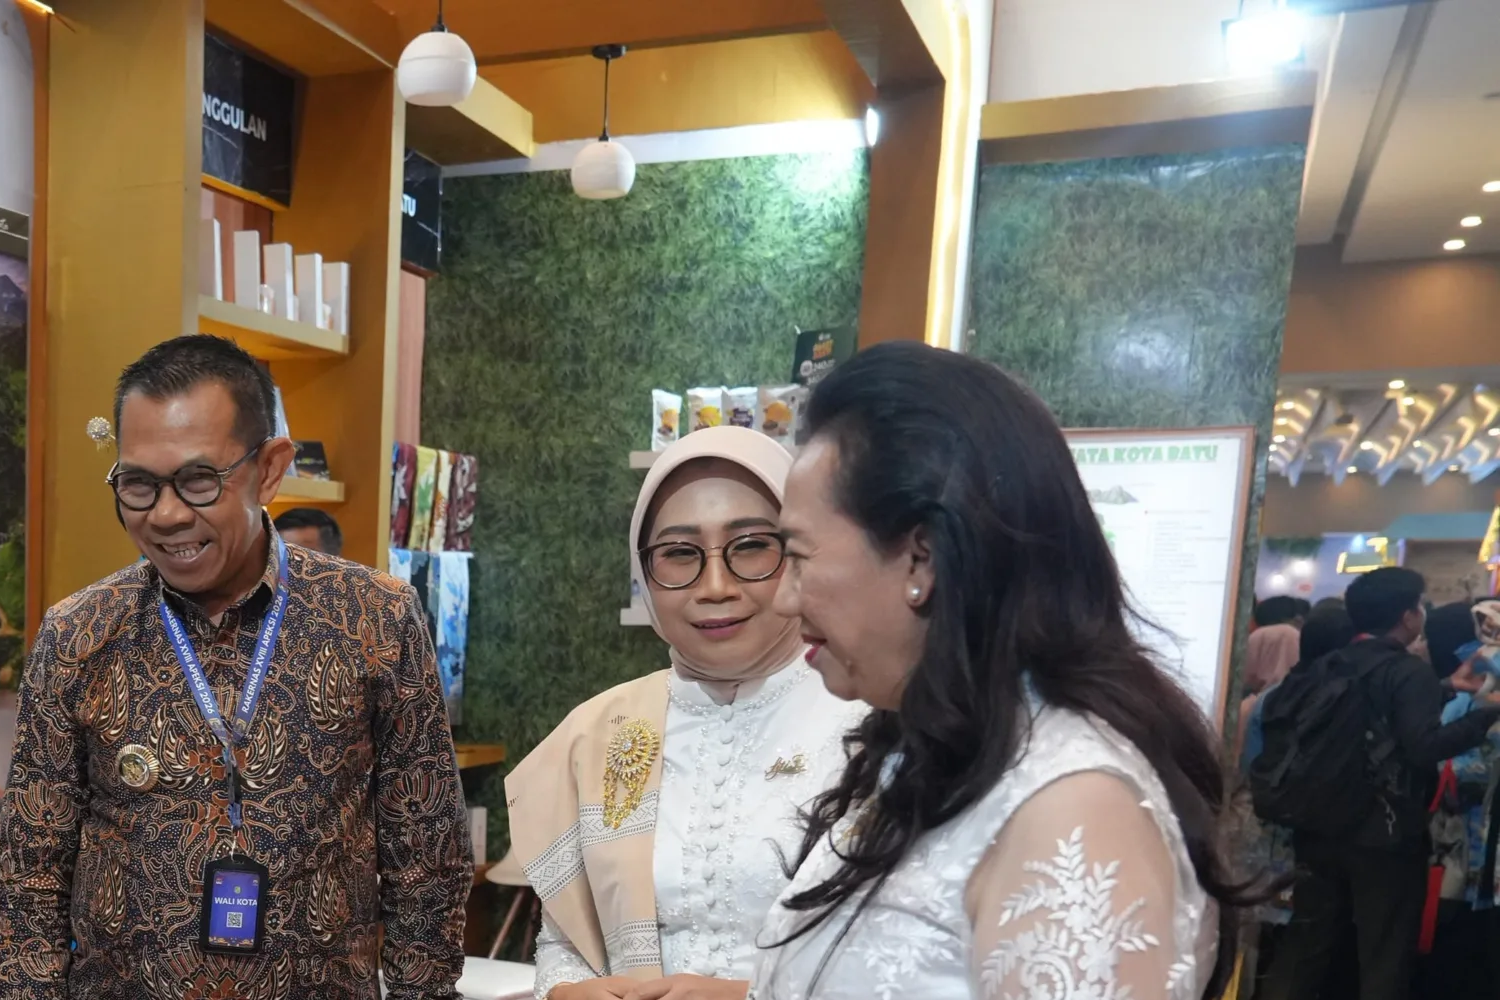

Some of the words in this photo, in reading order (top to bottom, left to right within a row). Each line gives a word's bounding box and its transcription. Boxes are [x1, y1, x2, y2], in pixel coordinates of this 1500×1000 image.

[1073, 447, 1109, 464] ATA
[1113, 446, 1163, 462] KOTA
[1167, 445, 1219, 462] BATU
[270, 594, 284, 617] 2026
[261, 617, 277, 648] APEKSI
[255, 647, 268, 668] XVIII
[180, 643, 193, 664] XVIII
[188, 663, 205, 691] APEKSI
[200, 692, 215, 714] 2026
[241, 666, 262, 714] RAKERNAS
[214, 896, 235, 905] WALI
[237, 898, 258, 906] KOTA
